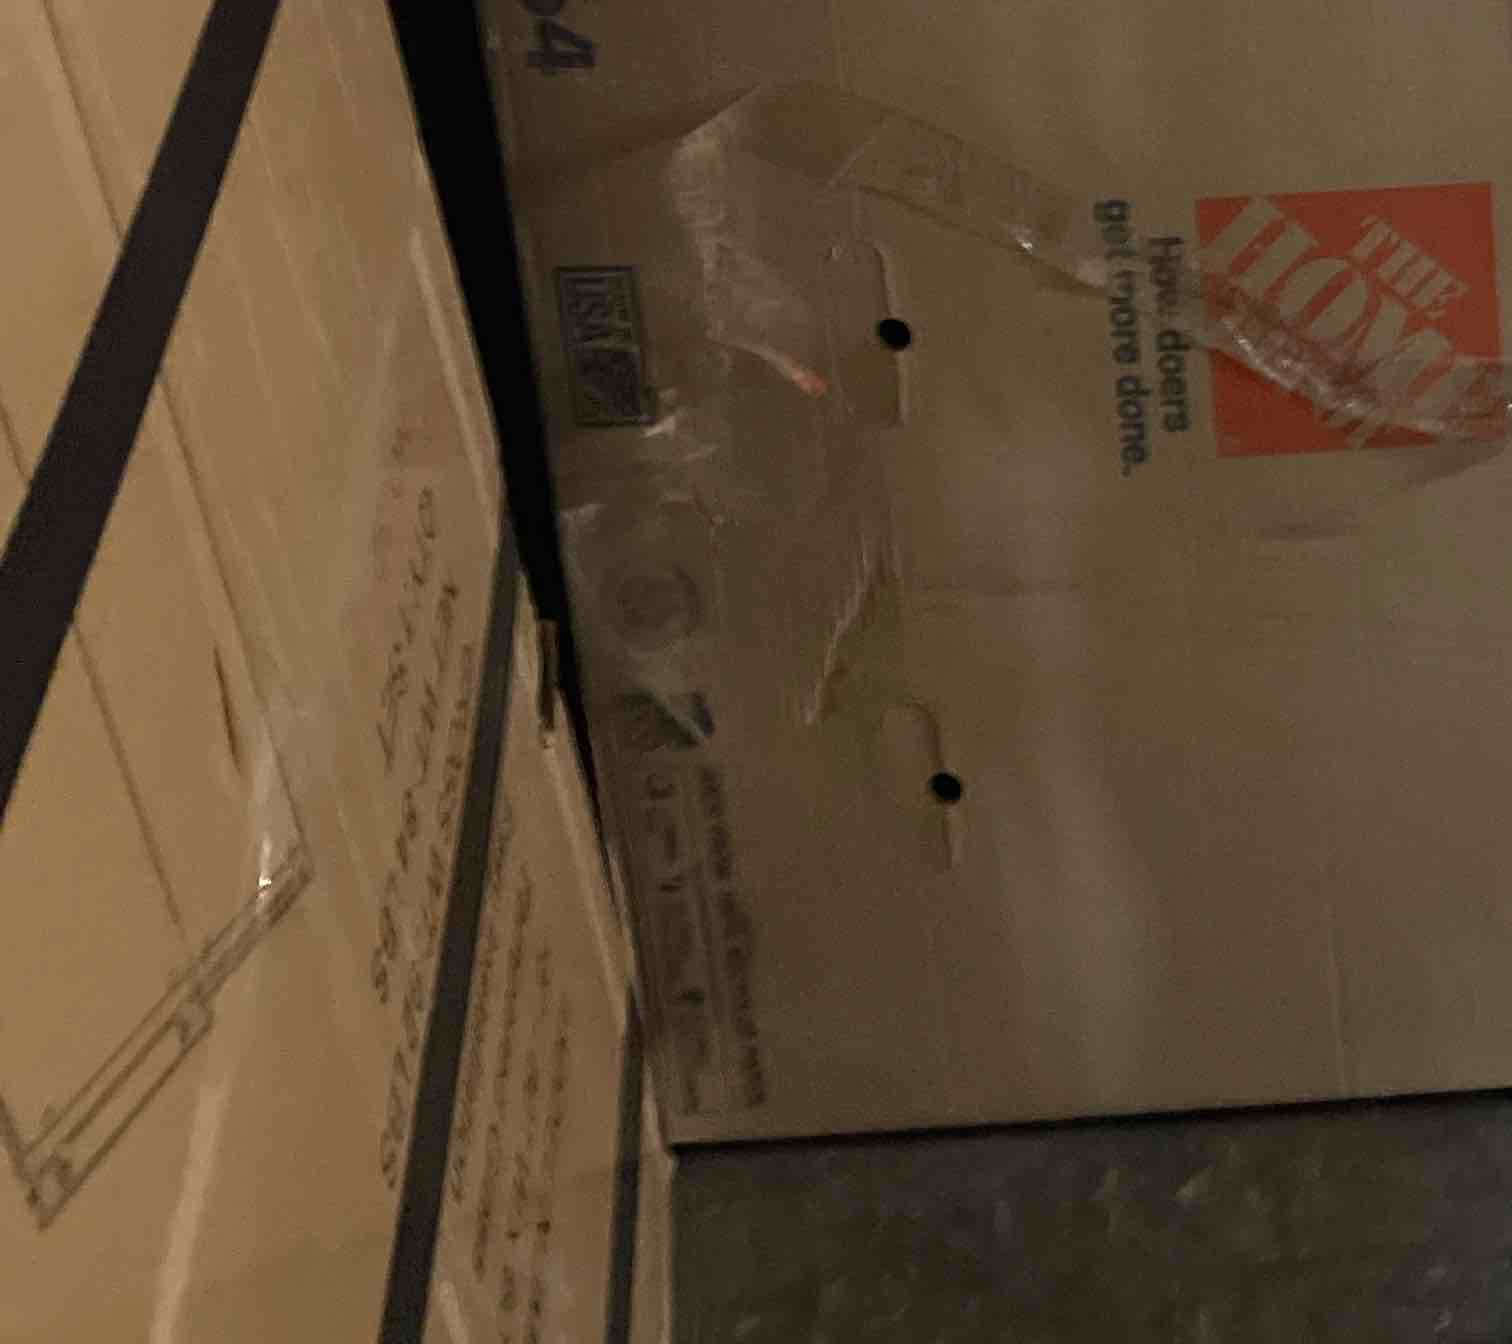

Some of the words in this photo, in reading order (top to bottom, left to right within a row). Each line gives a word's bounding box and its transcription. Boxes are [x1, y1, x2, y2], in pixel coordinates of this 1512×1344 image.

[1350, 215, 1470, 320] THE
[1116, 375, 1152, 478] done.
[1155, 328, 1191, 433] doers
